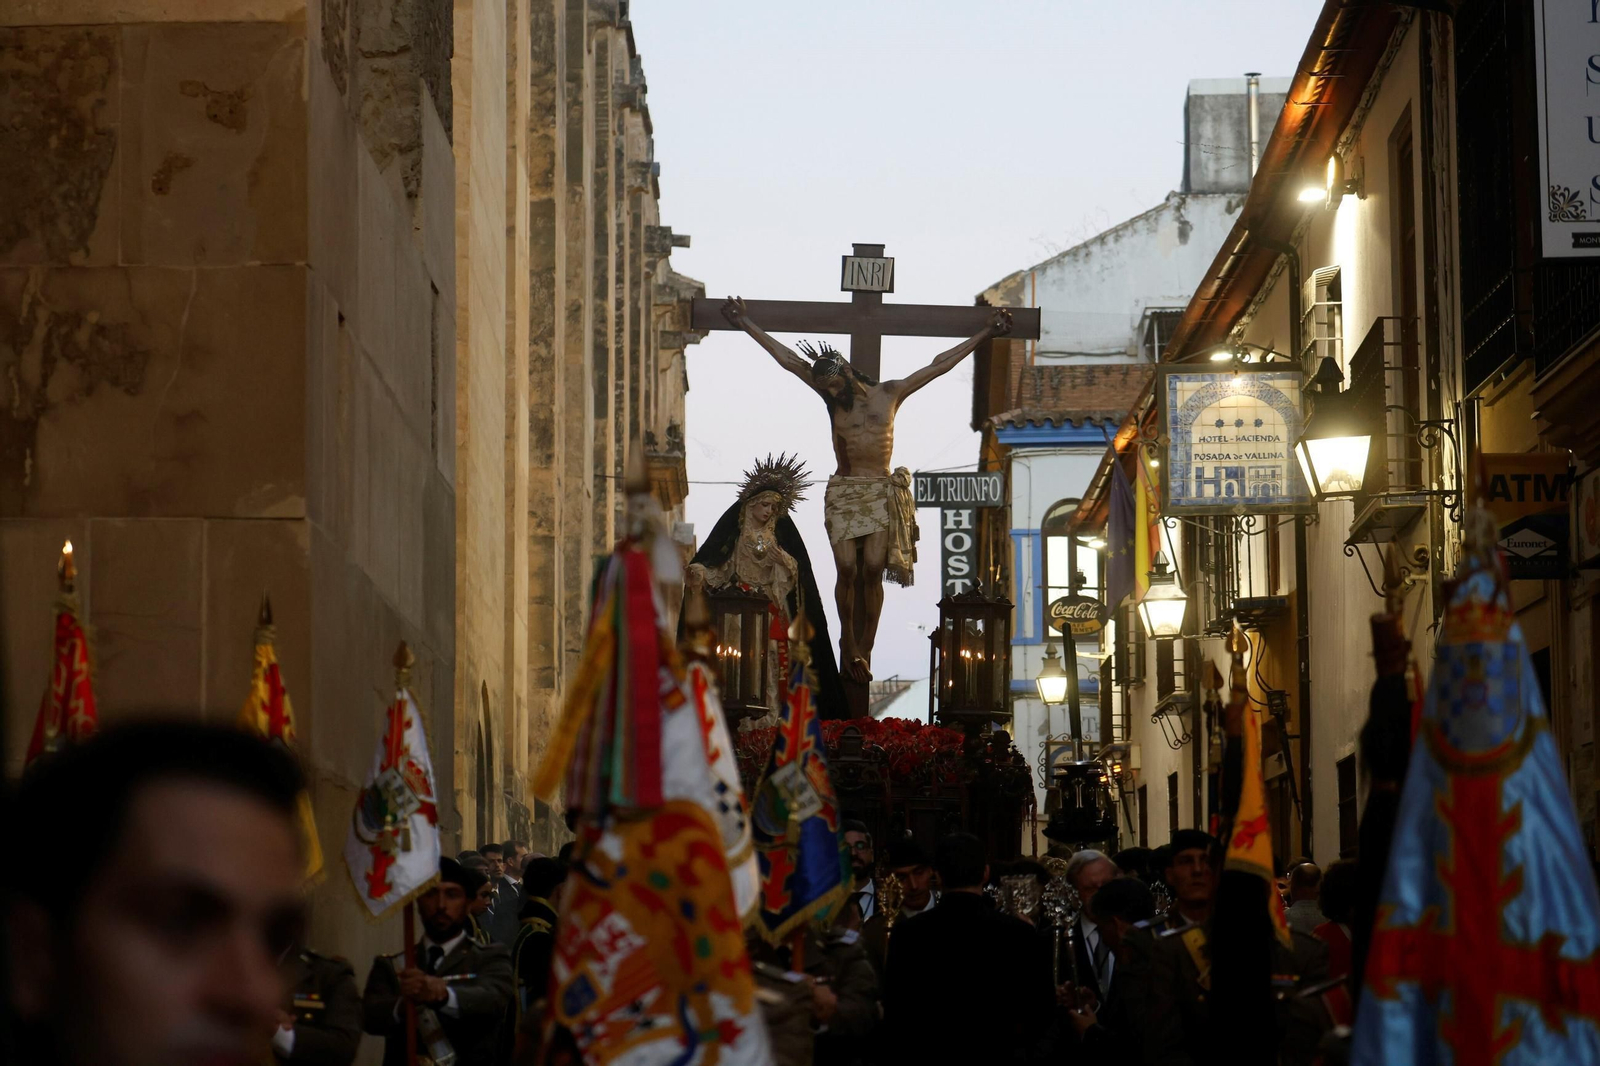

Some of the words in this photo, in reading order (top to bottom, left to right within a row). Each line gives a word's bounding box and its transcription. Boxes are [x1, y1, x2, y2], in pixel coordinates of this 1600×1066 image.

[850, 261, 886, 287] INRI
[1199, 435, 1229, 443] HOTEL
[1194, 453, 1231, 461] POSADA
[1244, 452, 1285, 460] VALLINA
[916, 477, 936, 502] EL
[937, 476, 1000, 502] TRIUNFO
[1490, 474, 1567, 502] ATM
[1507, 538, 1547, 549] Euronet
[1051, 602, 1099, 618] Coca-Cola
